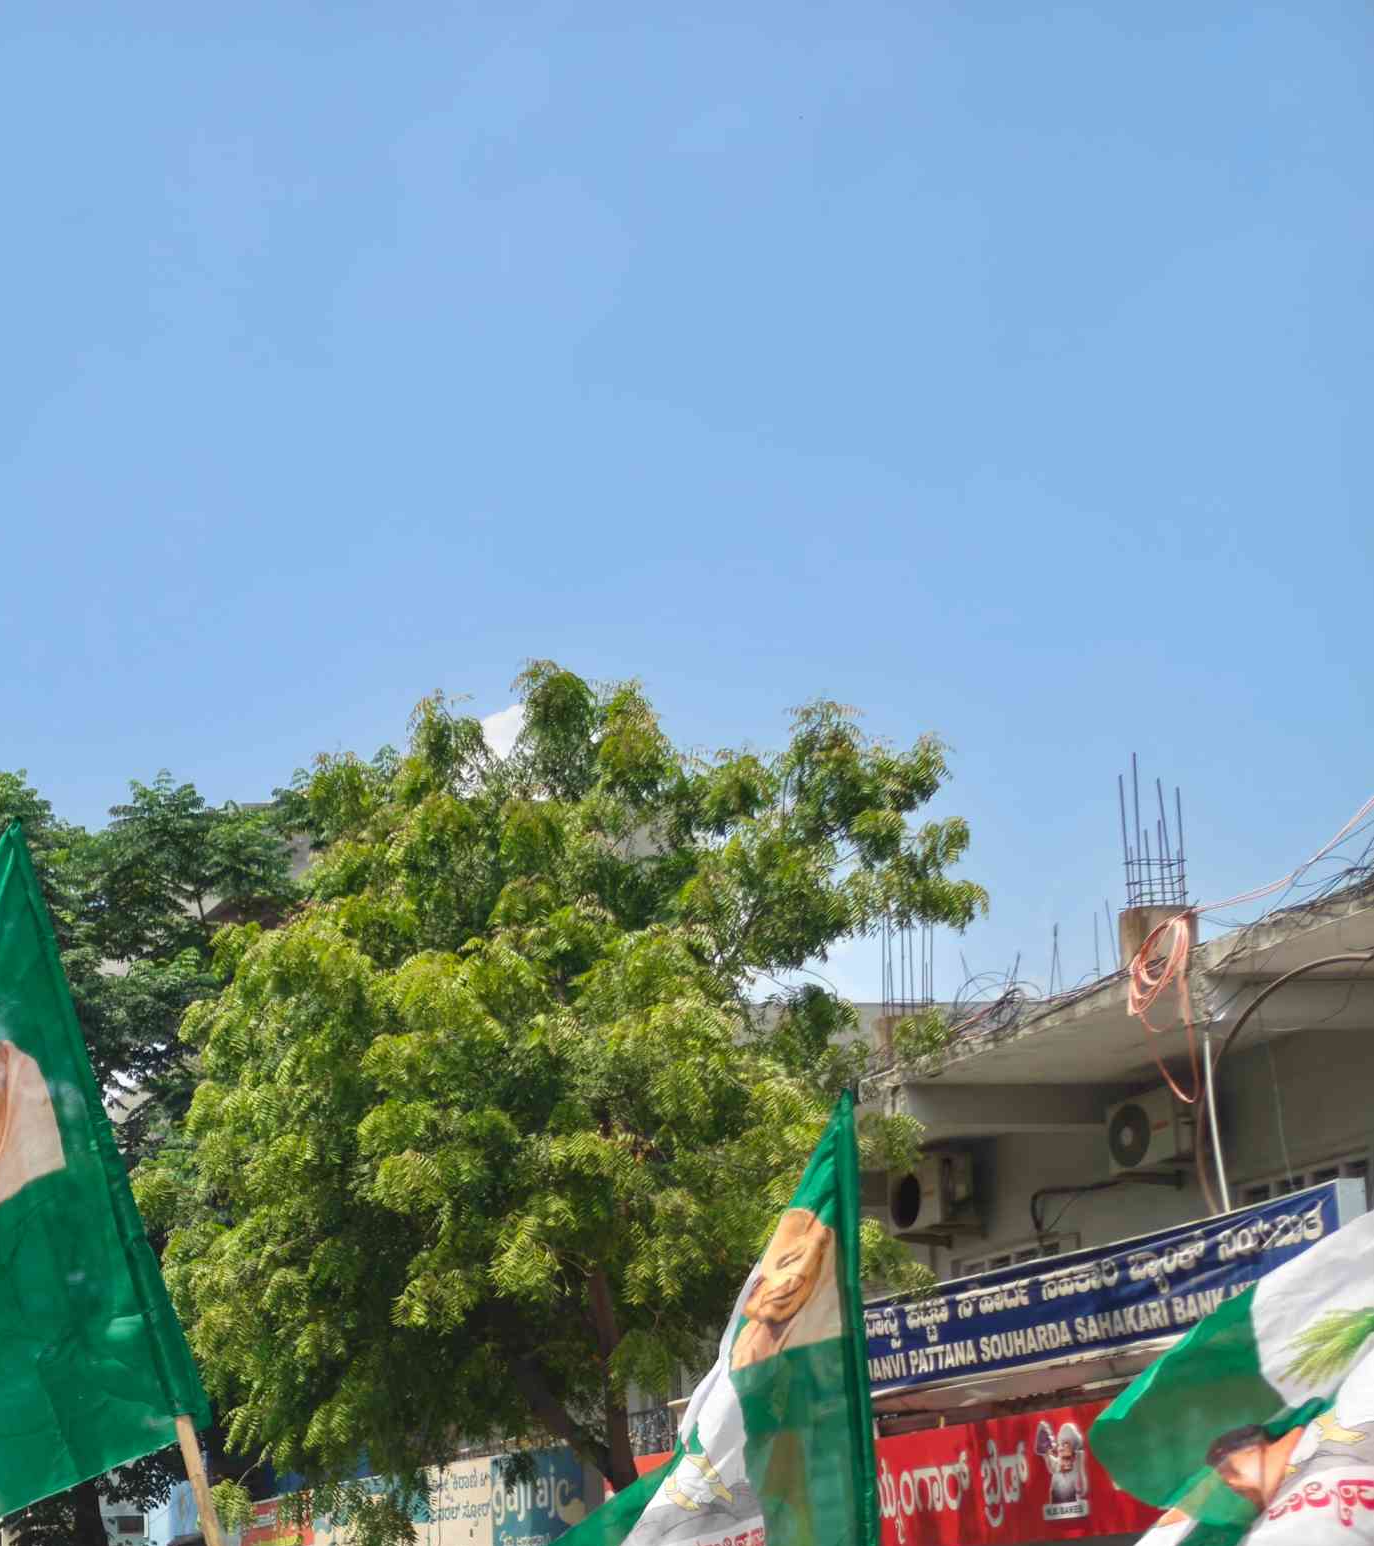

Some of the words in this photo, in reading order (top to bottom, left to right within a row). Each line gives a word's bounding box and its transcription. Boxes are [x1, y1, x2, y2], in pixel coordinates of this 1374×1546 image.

[909, 1339, 978, 1376] PATTANA
[980, 1320, 1074, 1363] SOUHARDA
[1074, 1299, 1172, 1345] SAHAKARI
[1172, 1286, 1226, 1325] BANK
